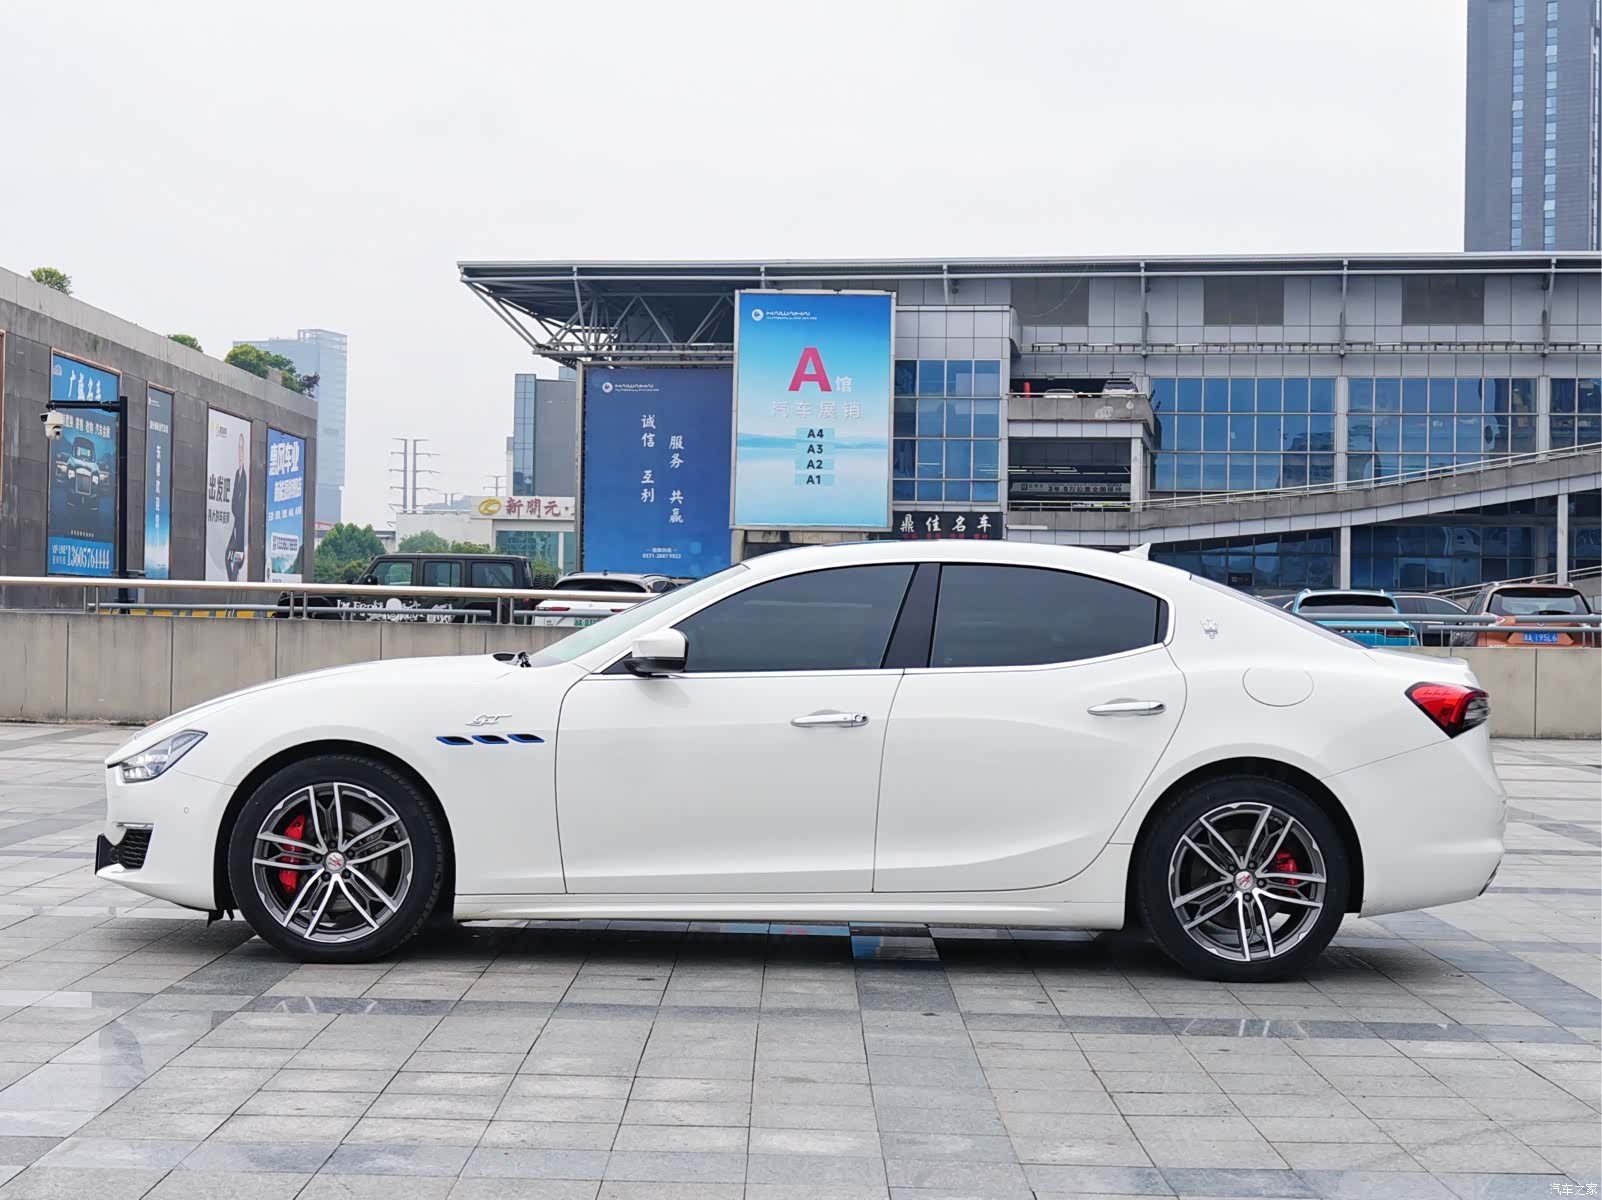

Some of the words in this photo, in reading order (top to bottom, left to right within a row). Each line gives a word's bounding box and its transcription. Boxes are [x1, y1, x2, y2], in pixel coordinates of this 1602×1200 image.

[773, 401, 862, 419] 汽车展销
[807, 429, 824, 438] A4
[807, 444, 824, 454] A3
[806, 460, 823, 469] A2
[806, 475, 821, 484] A1
[208, 473, 230, 502] 出发吧
[899, 513, 992, 533] 鼎佳名车
